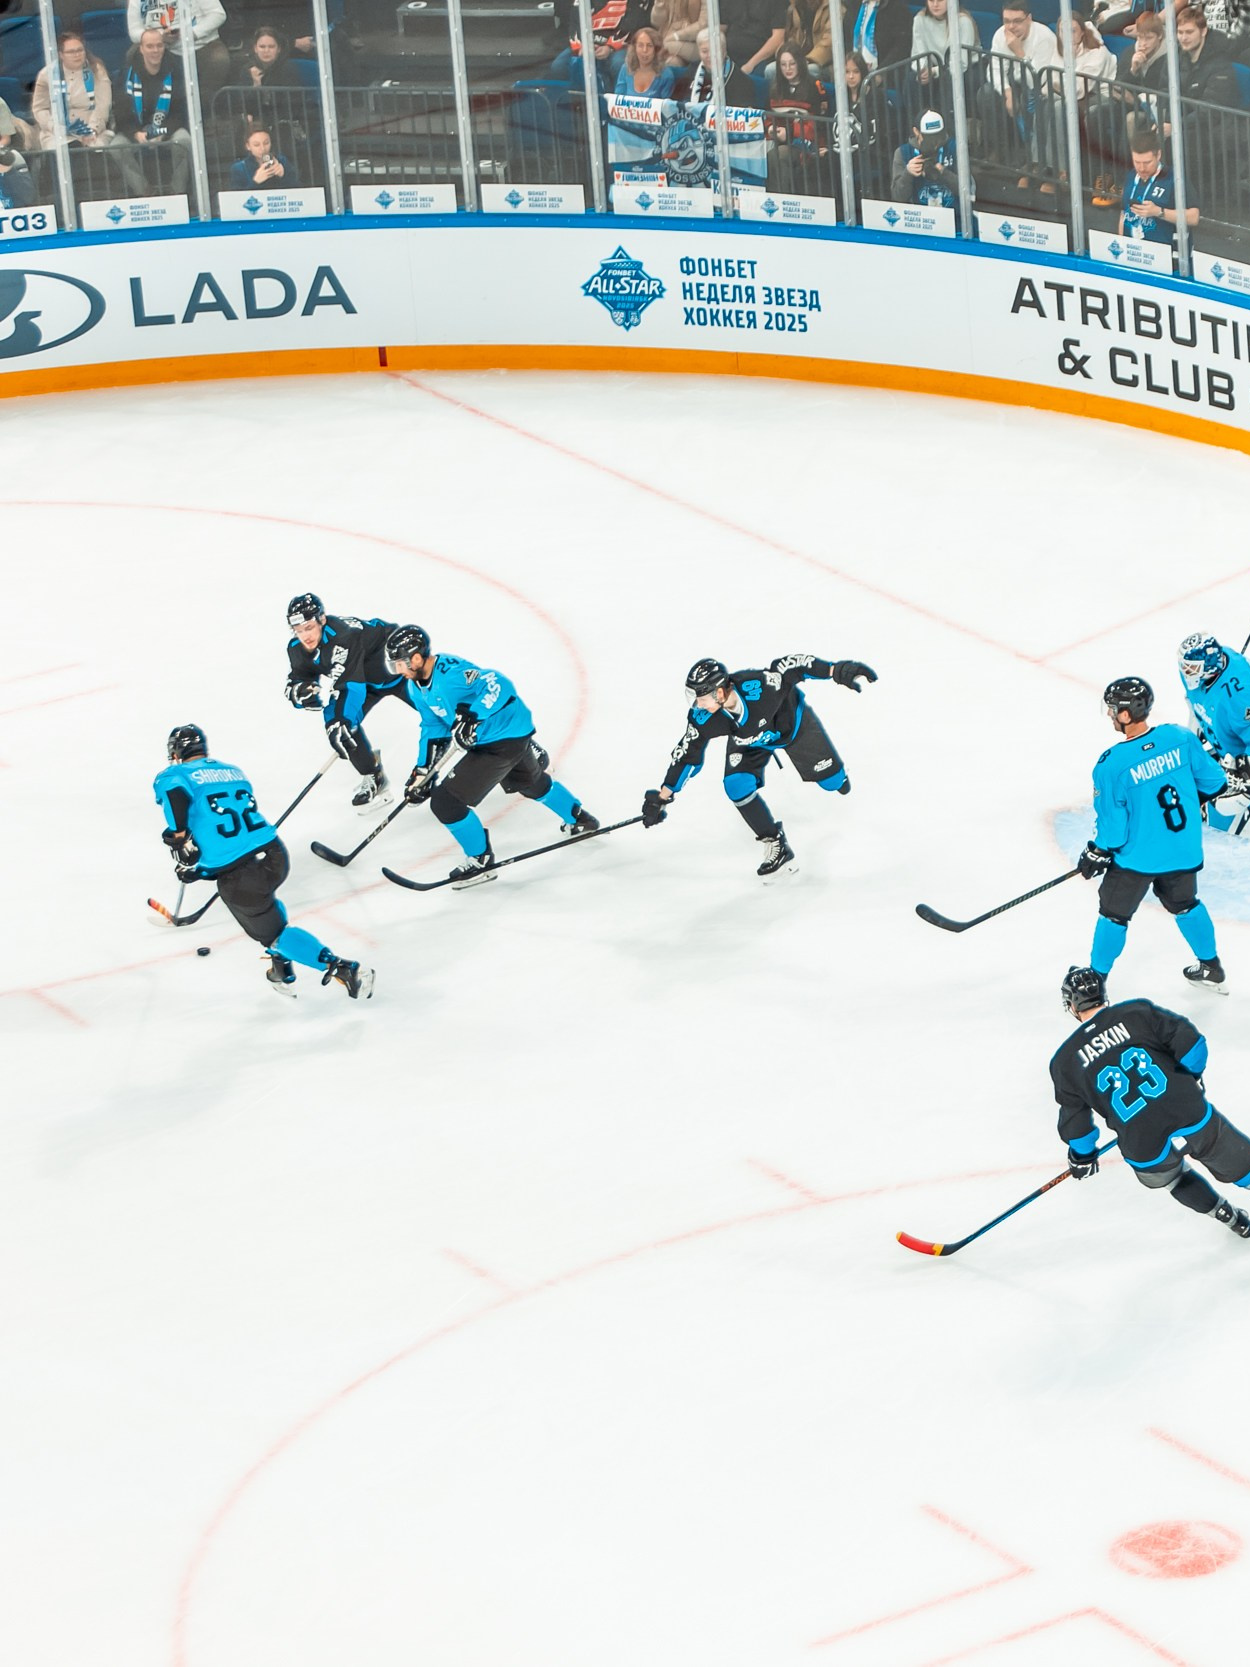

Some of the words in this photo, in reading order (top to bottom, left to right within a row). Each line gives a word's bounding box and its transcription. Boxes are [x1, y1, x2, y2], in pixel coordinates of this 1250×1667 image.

[611, 106, 660, 123] ЛЕГЕНДА
[711, 107, 761, 122] ерфи
[1152, 187, 1165, 197] 57
[608, 269, 636, 277] FONBET
[679, 256, 757, 279] ФОНБЕТ
[130, 265, 358, 327] LADA
[682, 281, 756, 305] НЕДЕЛЯ
[763, 286, 822, 312] ЗВЕЗД
[684, 306, 757, 330] ХОККЕЯ
[763, 311, 808, 333] 2025
[1058, 337, 1093, 379] &
[1109, 346, 1236, 411] CLUB
[741, 680, 763, 701] 49
[1221, 677, 1244, 698] 72
[1130, 748, 1182, 785] MURPHY
[206, 789, 267, 838] 52
[1157, 783, 1188, 833] 8
[1078, 1022, 1131, 1068] JASKIN
[1096, 1046, 1168, 1123] 23
